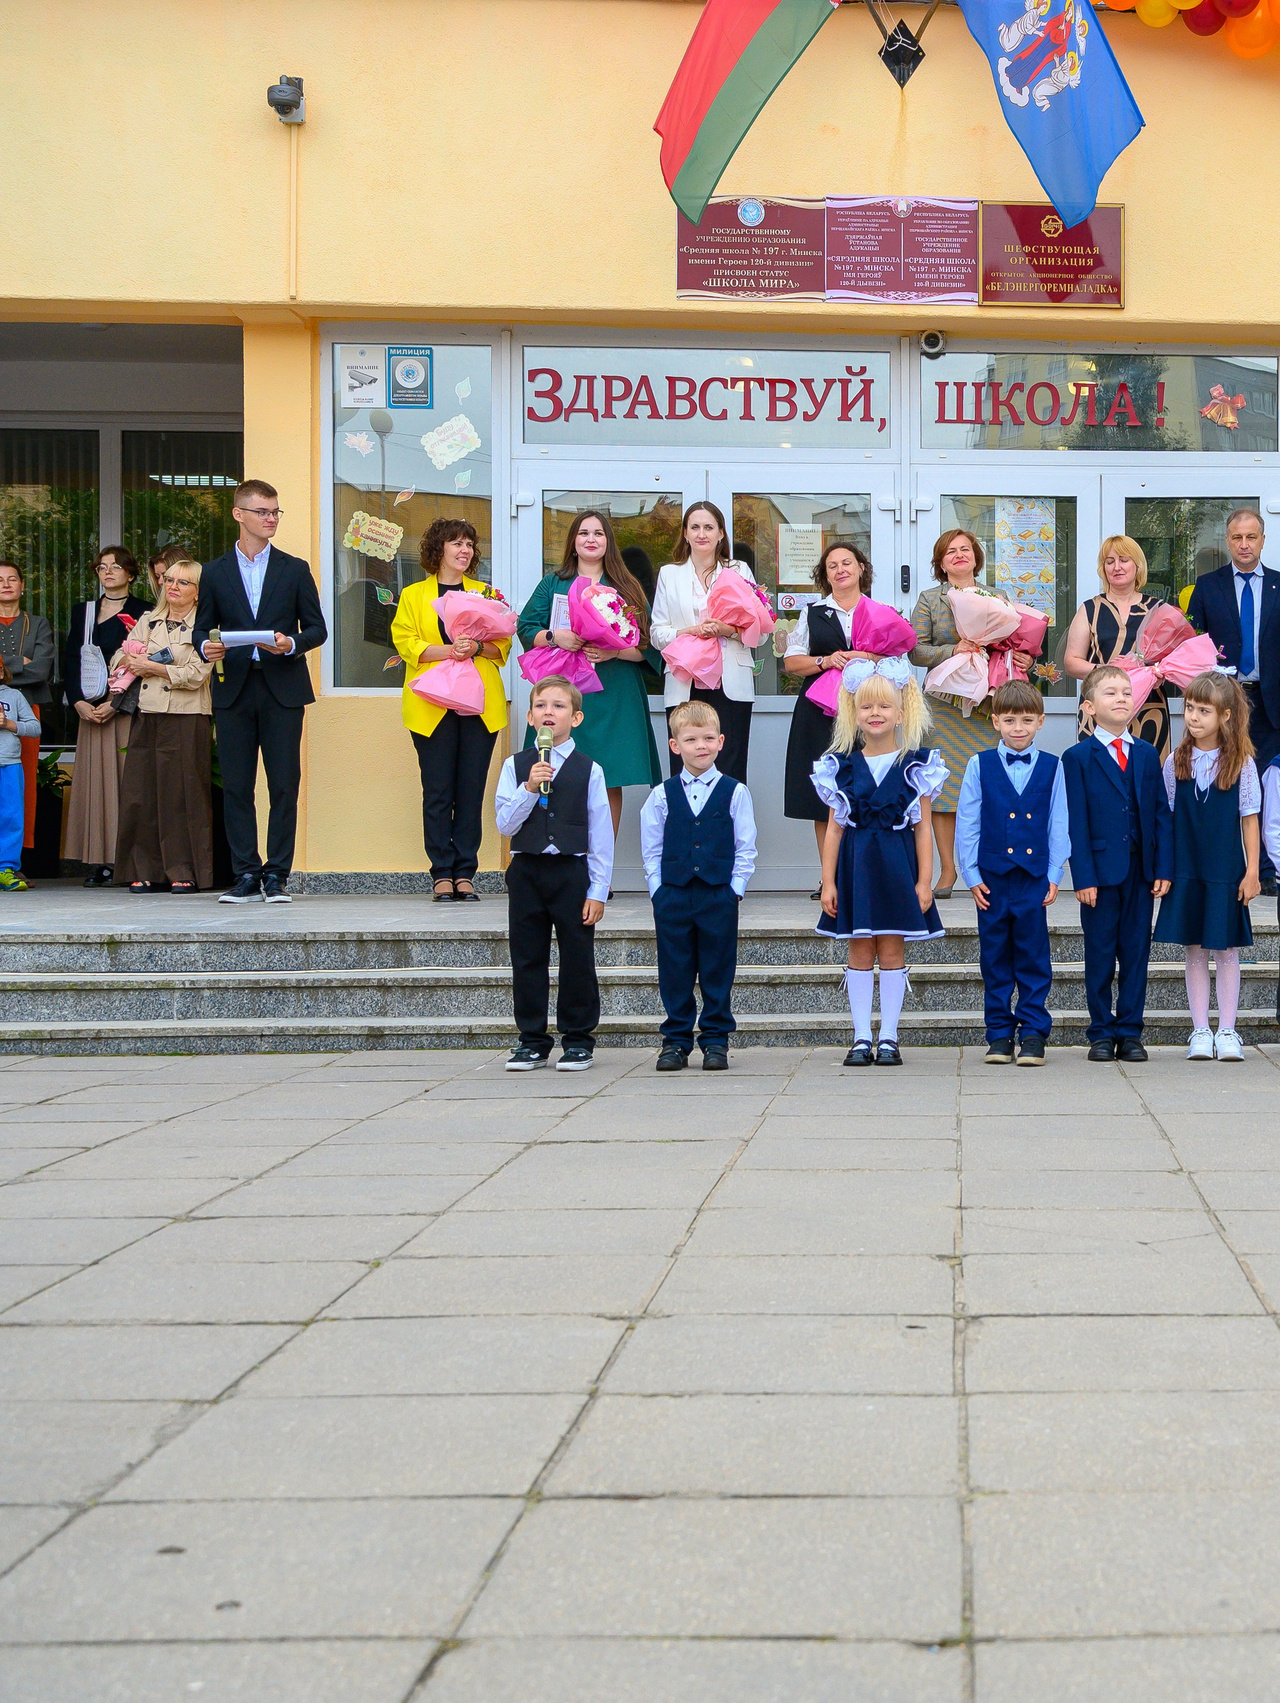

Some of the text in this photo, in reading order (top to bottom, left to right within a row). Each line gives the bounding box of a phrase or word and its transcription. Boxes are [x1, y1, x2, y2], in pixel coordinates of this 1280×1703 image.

[712, 228, 791, 236] ГОСУДАРСТВЕННОМУ
[752, 236, 806, 244] ОБРАЗОВАНИЯ
[679, 246, 720, 256] «Средняя
[763, 247, 779, 255] 197
[790, 248, 823, 257] Минска
[1004, 244, 1100, 255] ШЕФСТВУЮЩАЯ
[718, 257, 748, 266] Героев
[750, 258, 772, 266] 120-й
[872, 256, 900, 264] ШКОЛА
[1009, 256, 1094, 267] ОРГАНИЗАЦИЯ
[713, 269, 757, 277] ПРИСВОЕН
[864, 264, 895, 272] МІНСКА
[702, 278, 800, 289] «ШКОЛА МИРА»
[985, 282, 1118, 294] «БЕЛЭНЕРГОРЕМНАЛАДКА»
[390, 348, 431, 356] МИЛИЦИЯ
[527, 366, 887, 433] ЗДРАВСТВУЙ,
[435, 423, 454, 437] Буду
[367, 527, 395, 542] осенние
